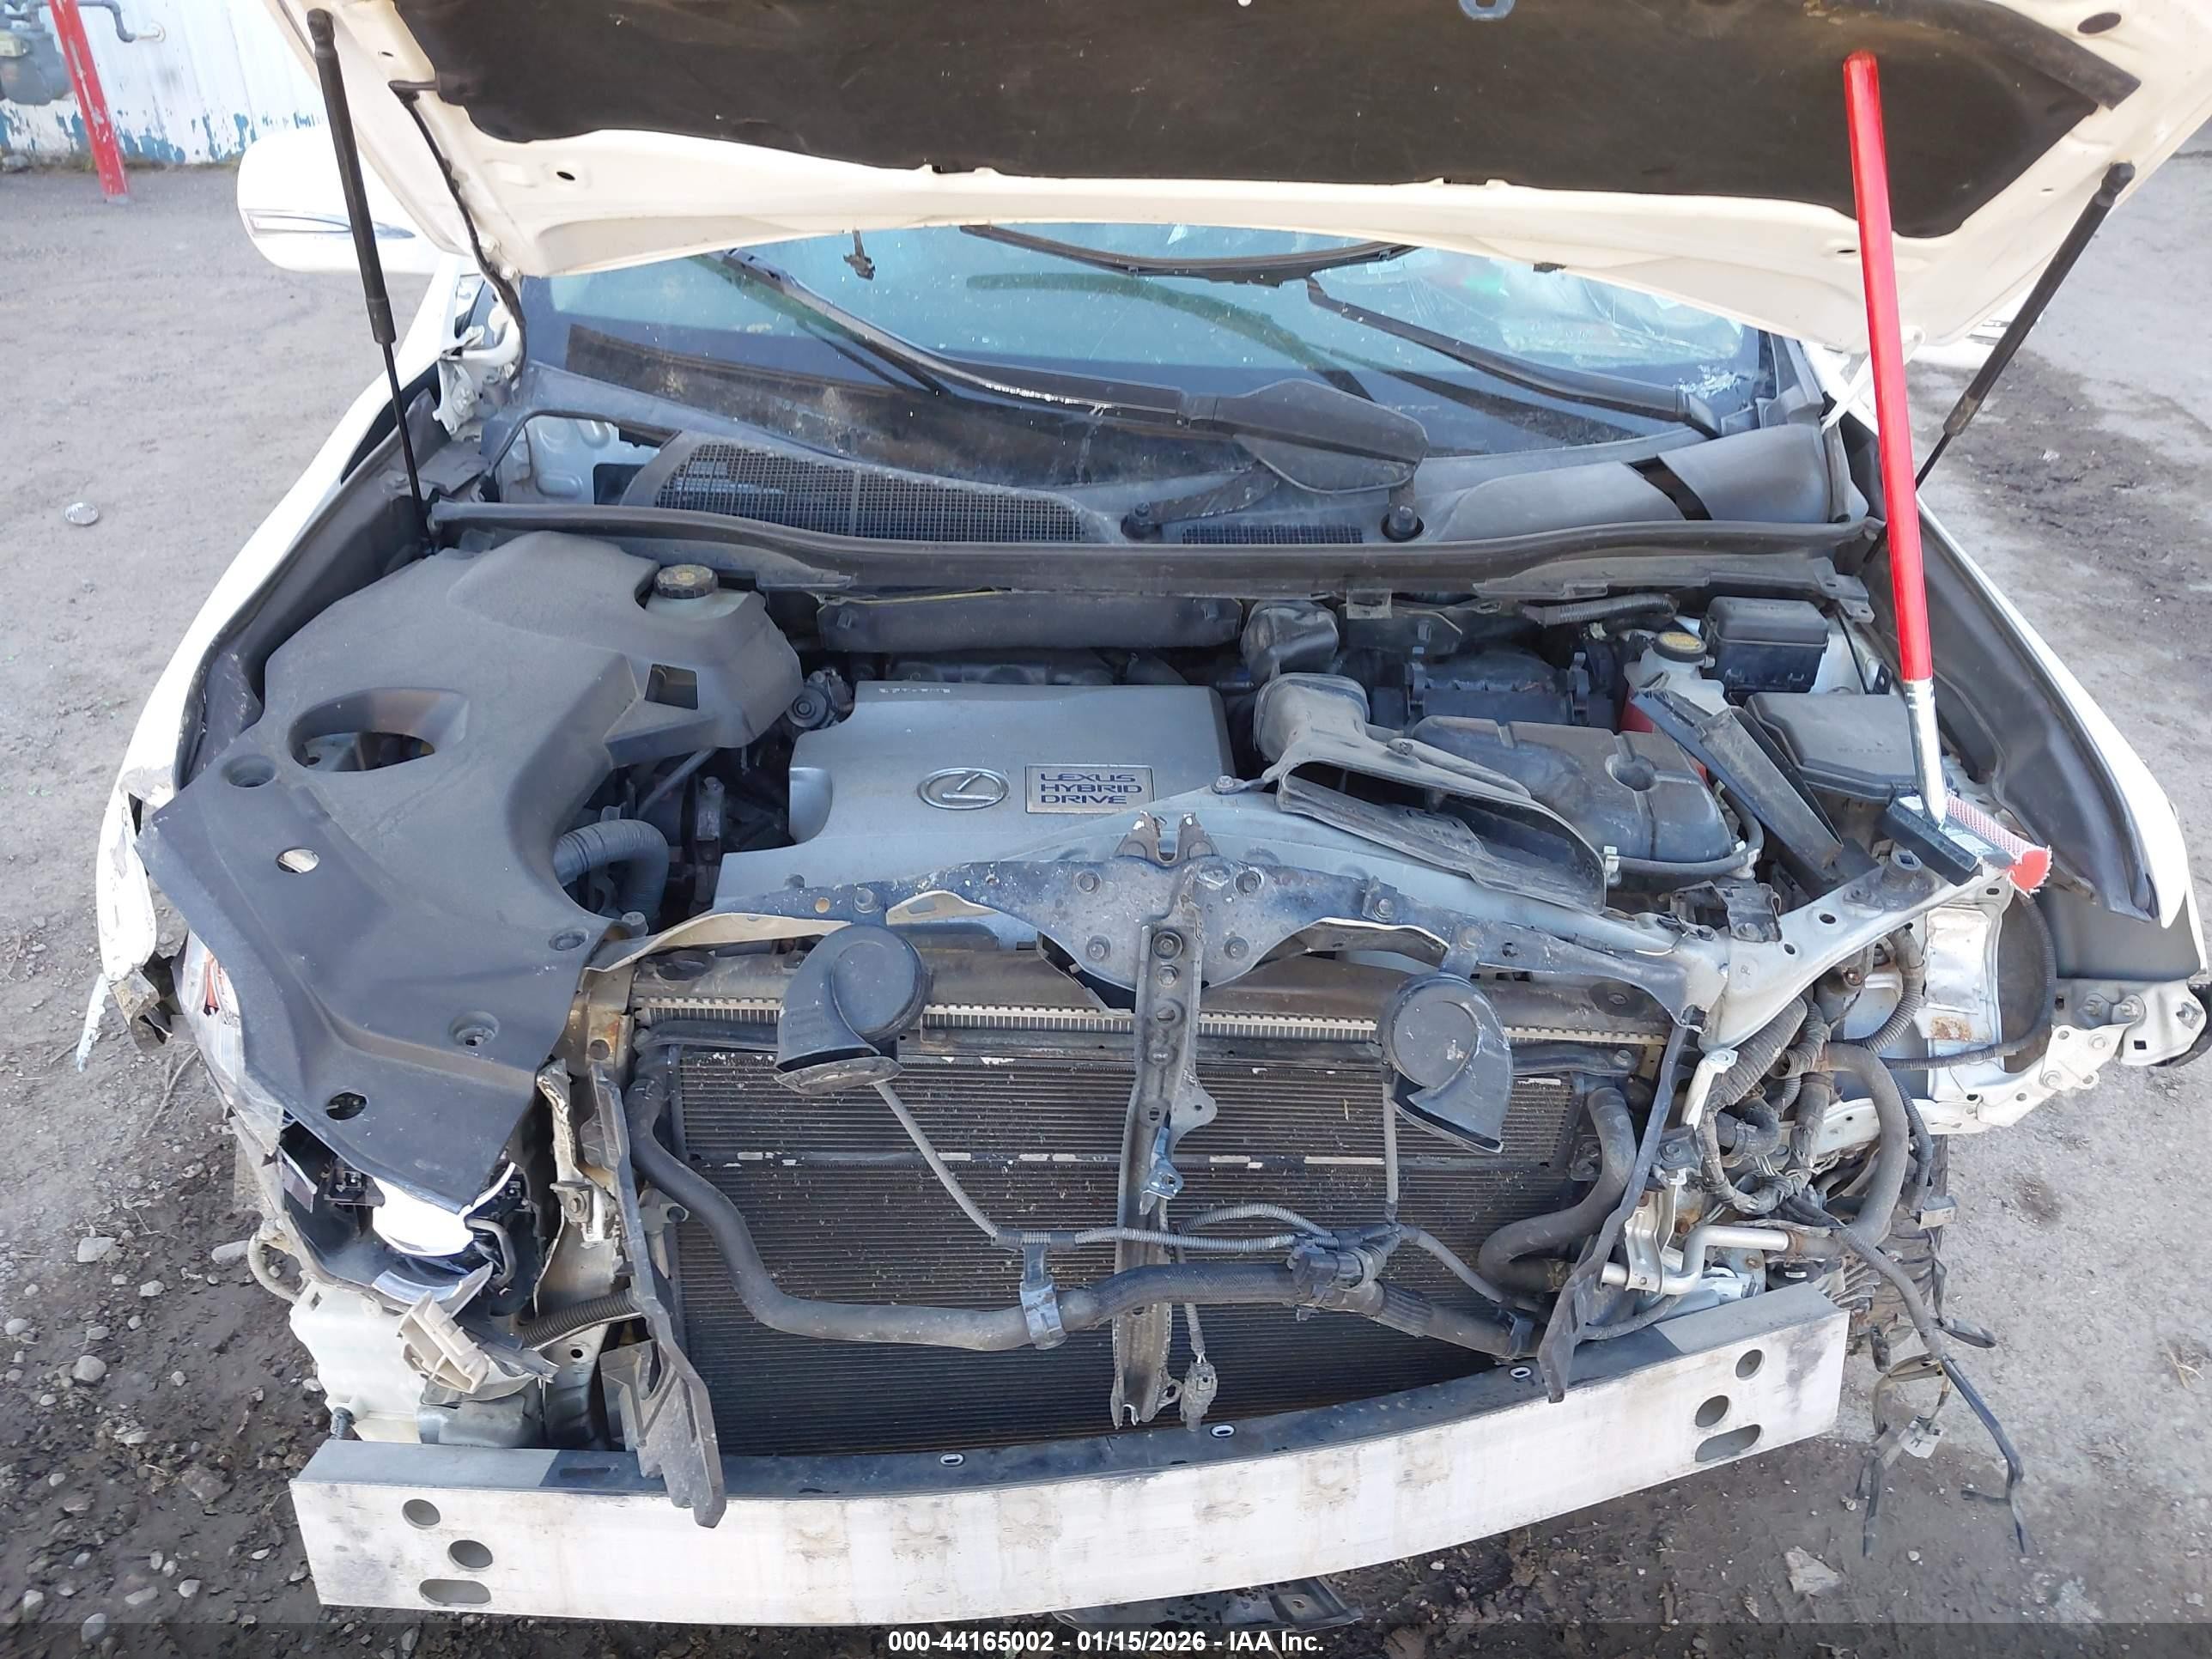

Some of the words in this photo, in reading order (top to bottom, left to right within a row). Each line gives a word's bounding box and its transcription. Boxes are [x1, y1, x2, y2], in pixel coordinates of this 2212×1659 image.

[1040, 773, 1136, 782] LEXUS
[1040, 783, 1143, 793] HYBRID
[1041, 794, 1127, 805] DRIVE
